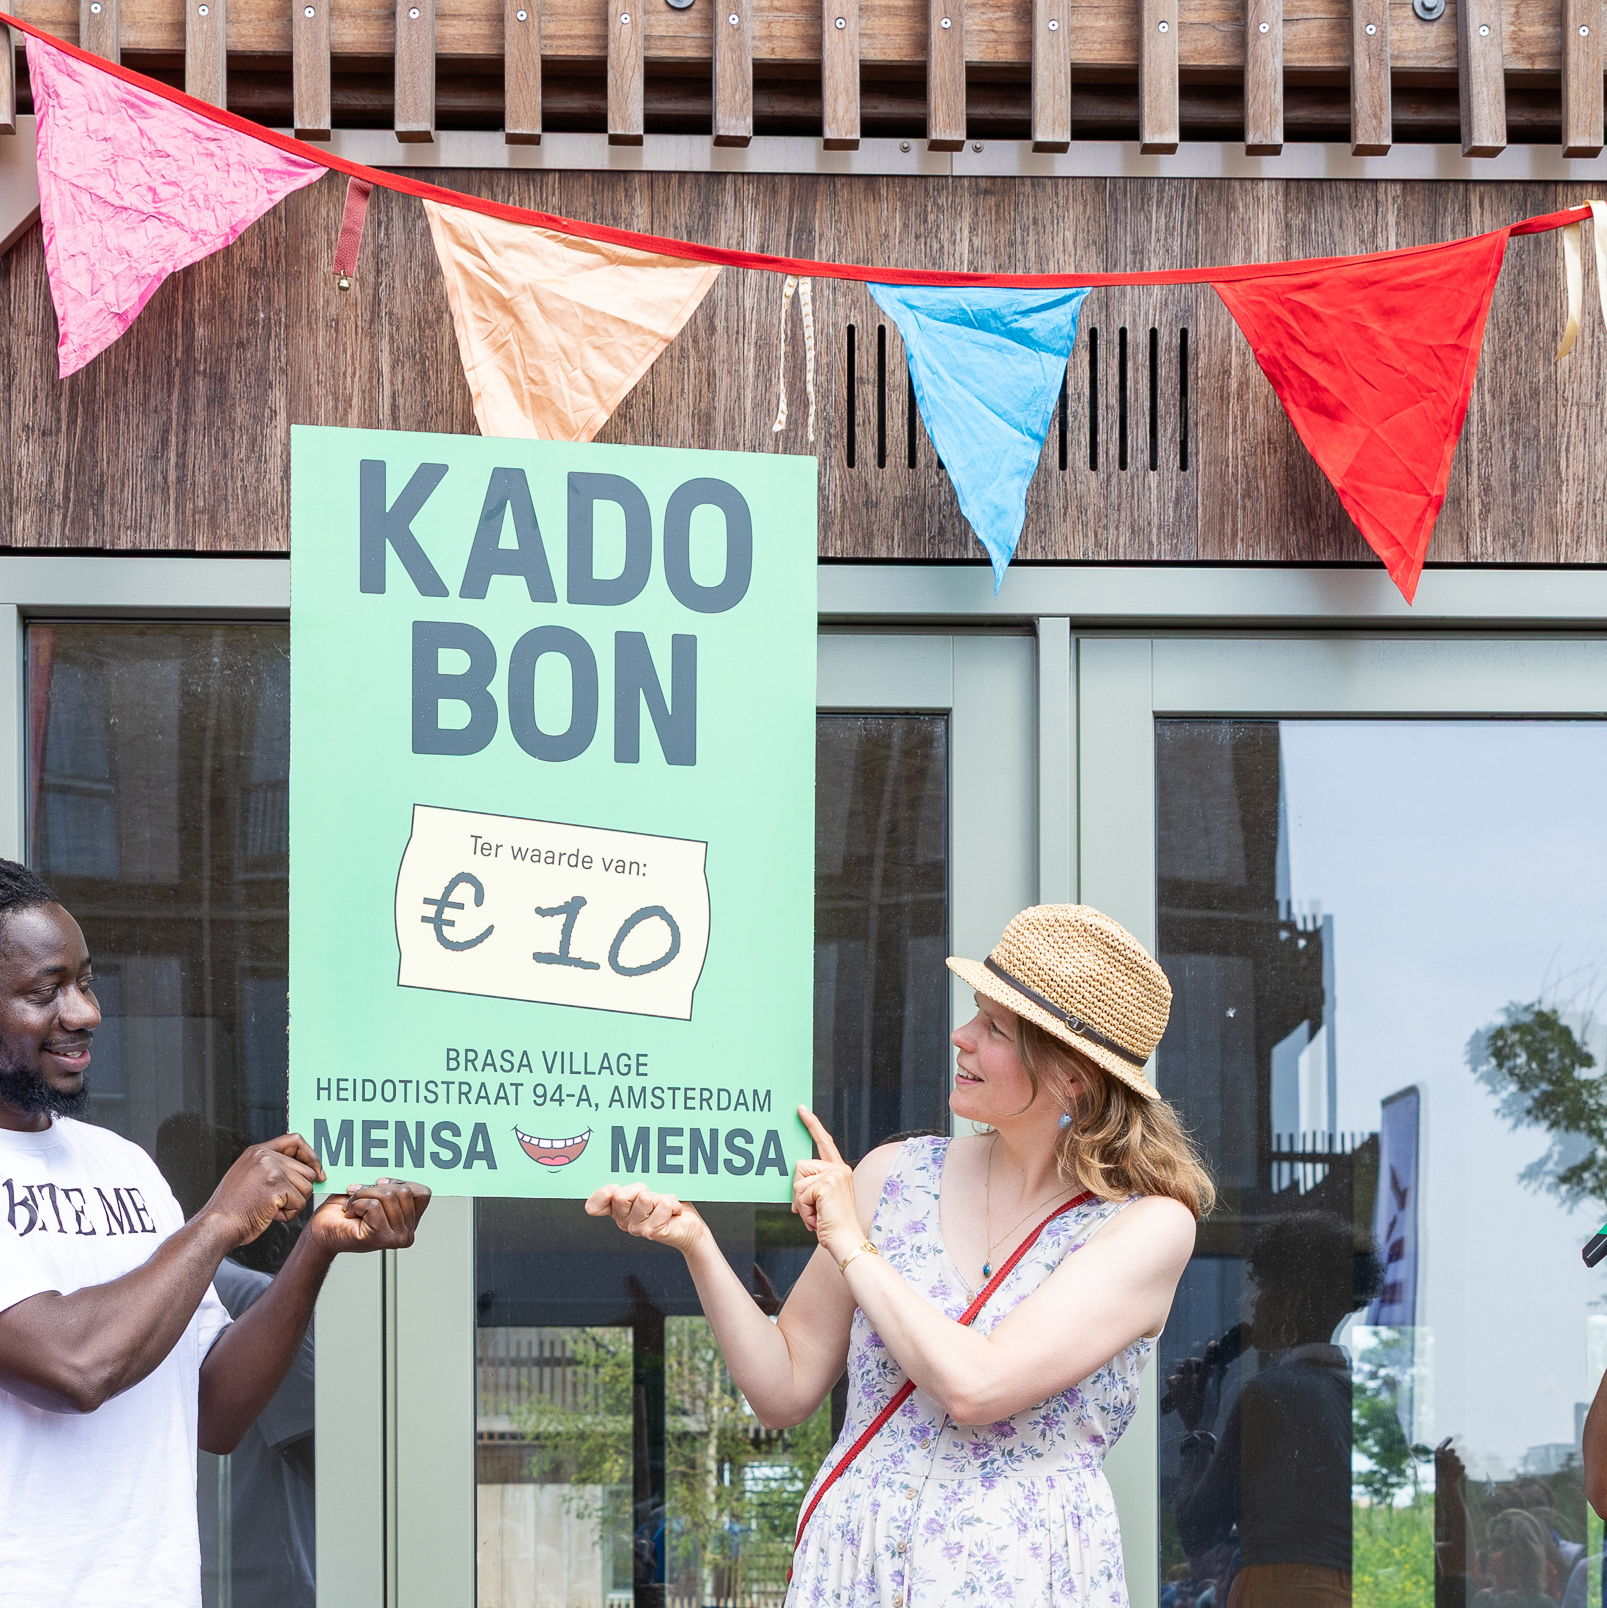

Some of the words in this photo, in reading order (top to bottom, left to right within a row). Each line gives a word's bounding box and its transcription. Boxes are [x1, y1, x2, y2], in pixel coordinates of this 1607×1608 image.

[359, 460, 753, 613] KADO
[412, 621, 698, 766] BON
[470, 835, 503, 860] Ter
[511, 841, 593, 870] waarde
[601, 855, 648, 877] van:
[421, 871, 494, 953] €
[533, 895, 682, 977] 10
[446, 1048, 532, 1074] BRASA
[542, 1051, 649, 1077] VILLAGE
[316, 1077, 524, 1106] HEIDOTISTRAAT
[533, 1083, 601, 1112] 94-A,
[608, 1085, 772, 1113] AMSTERDAM
[312, 1118, 498, 1170] MENSA
[610, 1126, 789, 1177] MENSA
[93, 1186, 157, 1236] ME
